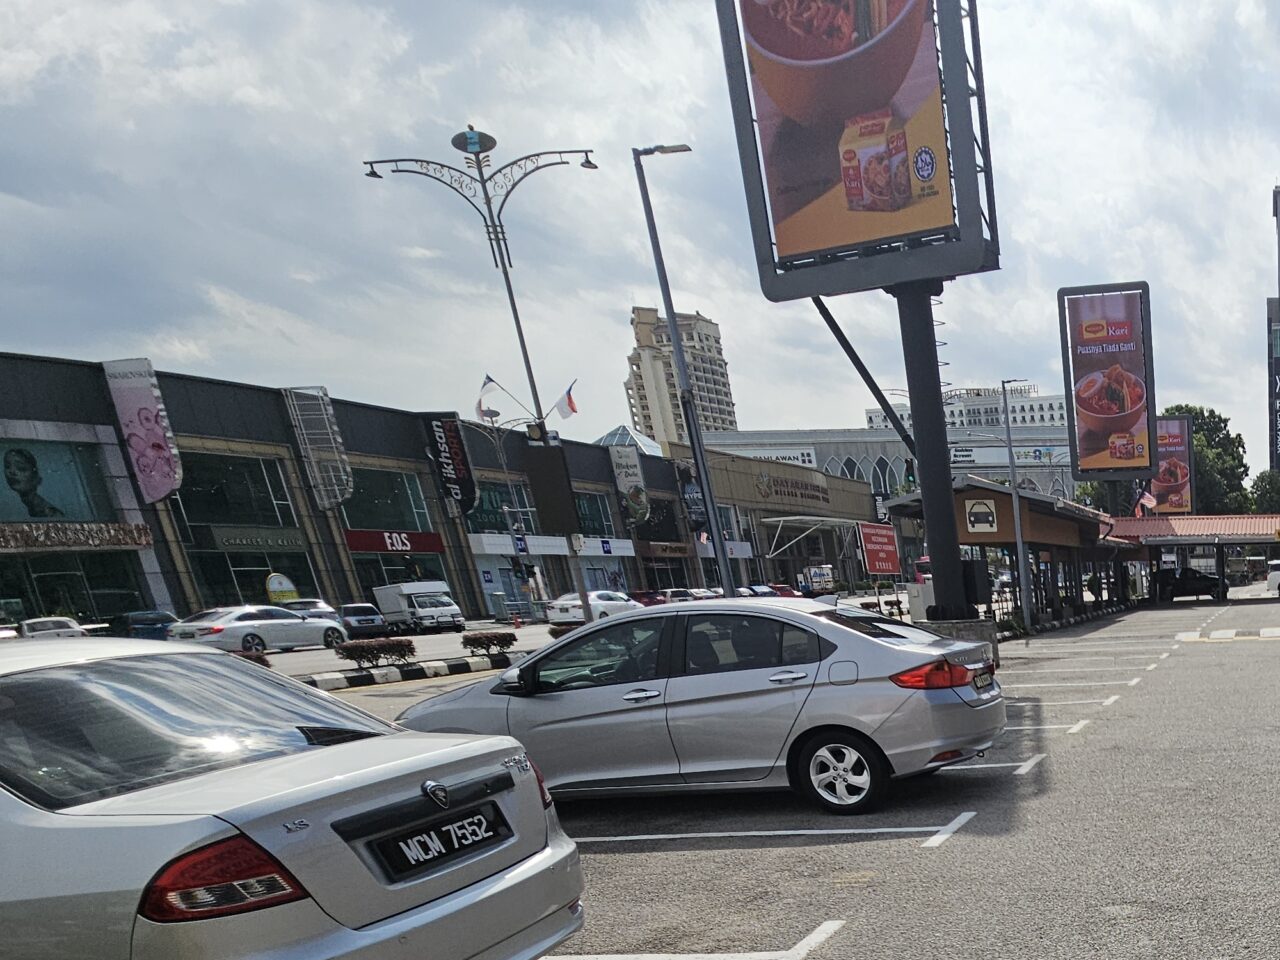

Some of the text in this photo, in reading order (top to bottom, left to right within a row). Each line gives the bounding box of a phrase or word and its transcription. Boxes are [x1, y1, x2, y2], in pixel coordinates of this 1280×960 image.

[1108, 326, 1128, 336] Kari
[1103, 344, 1119, 352] Tiada
[1120, 342, 1136, 352] Ganti
[966, 387, 1004, 398] HERITAG
[1009, 384, 1038, 395] HOTEL
[432, 420, 462, 500] al ikhsan
[398, 815, 493, 865] MCM 7552
